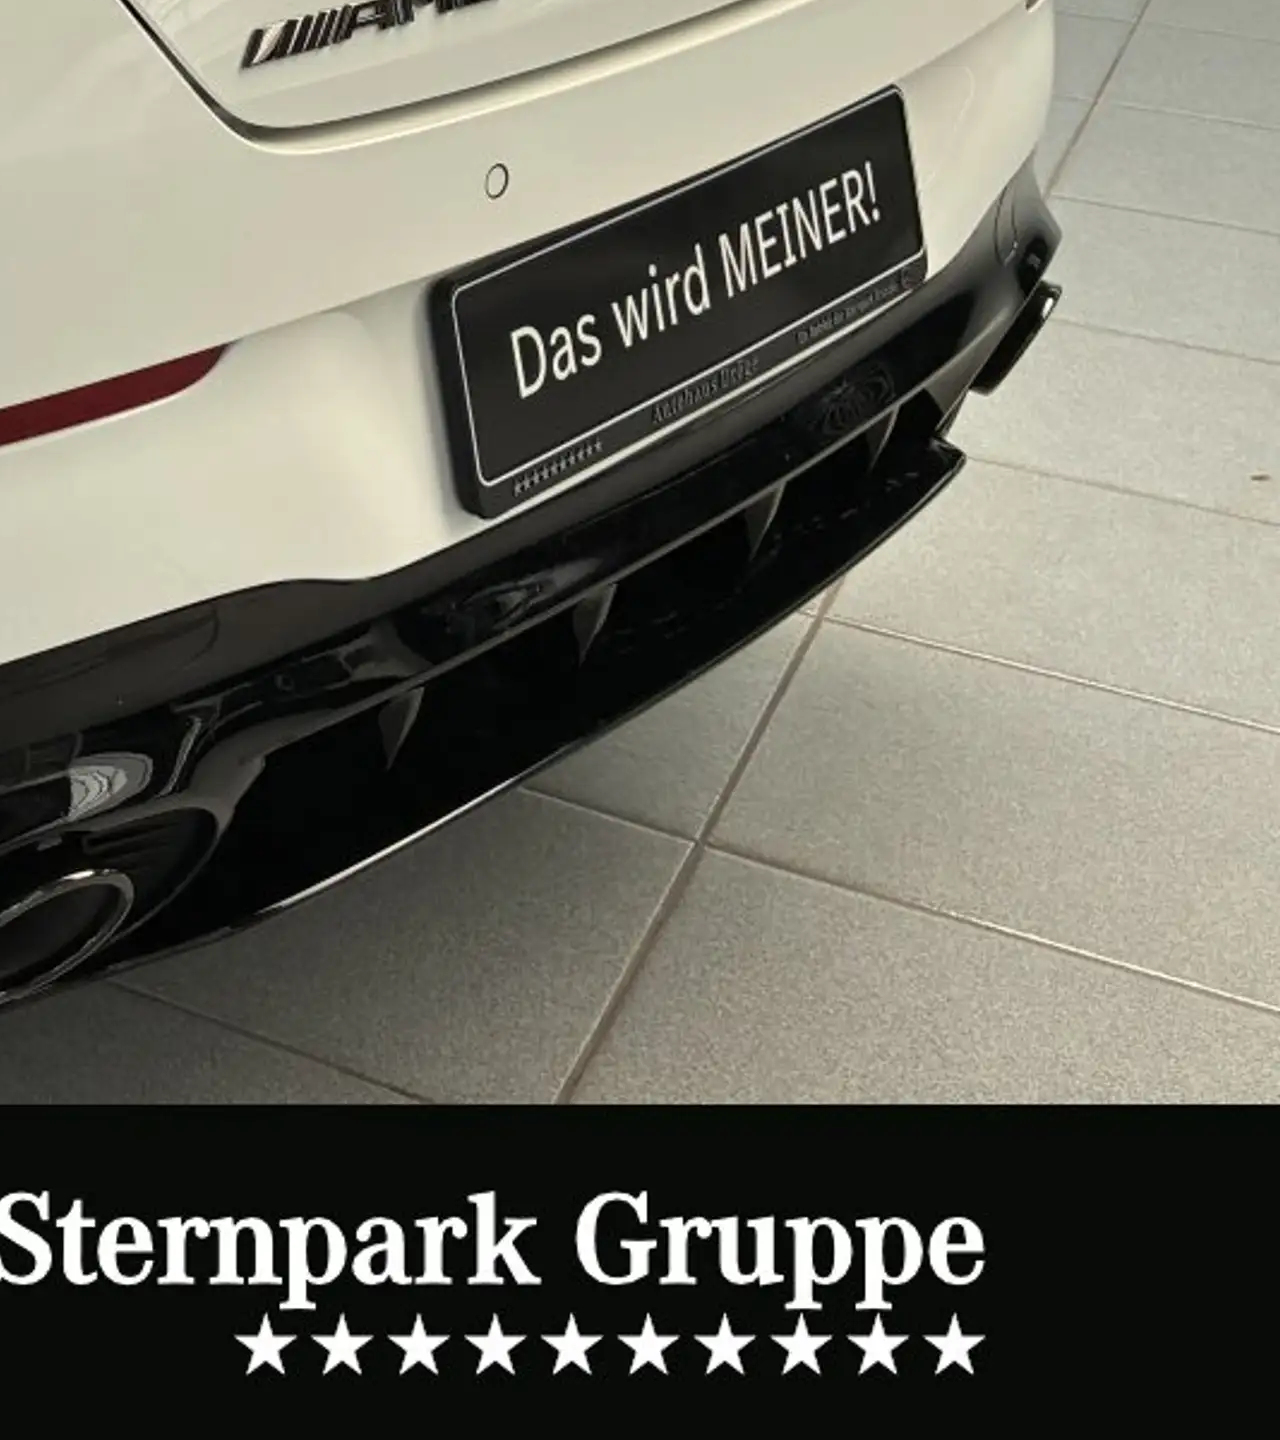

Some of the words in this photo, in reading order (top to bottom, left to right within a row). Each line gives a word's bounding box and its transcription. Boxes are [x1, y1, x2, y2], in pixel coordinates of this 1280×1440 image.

[509, 313, 603, 400] Das
[611, 243, 712, 349] wird
[718, 160, 882, 299] MEINER!
